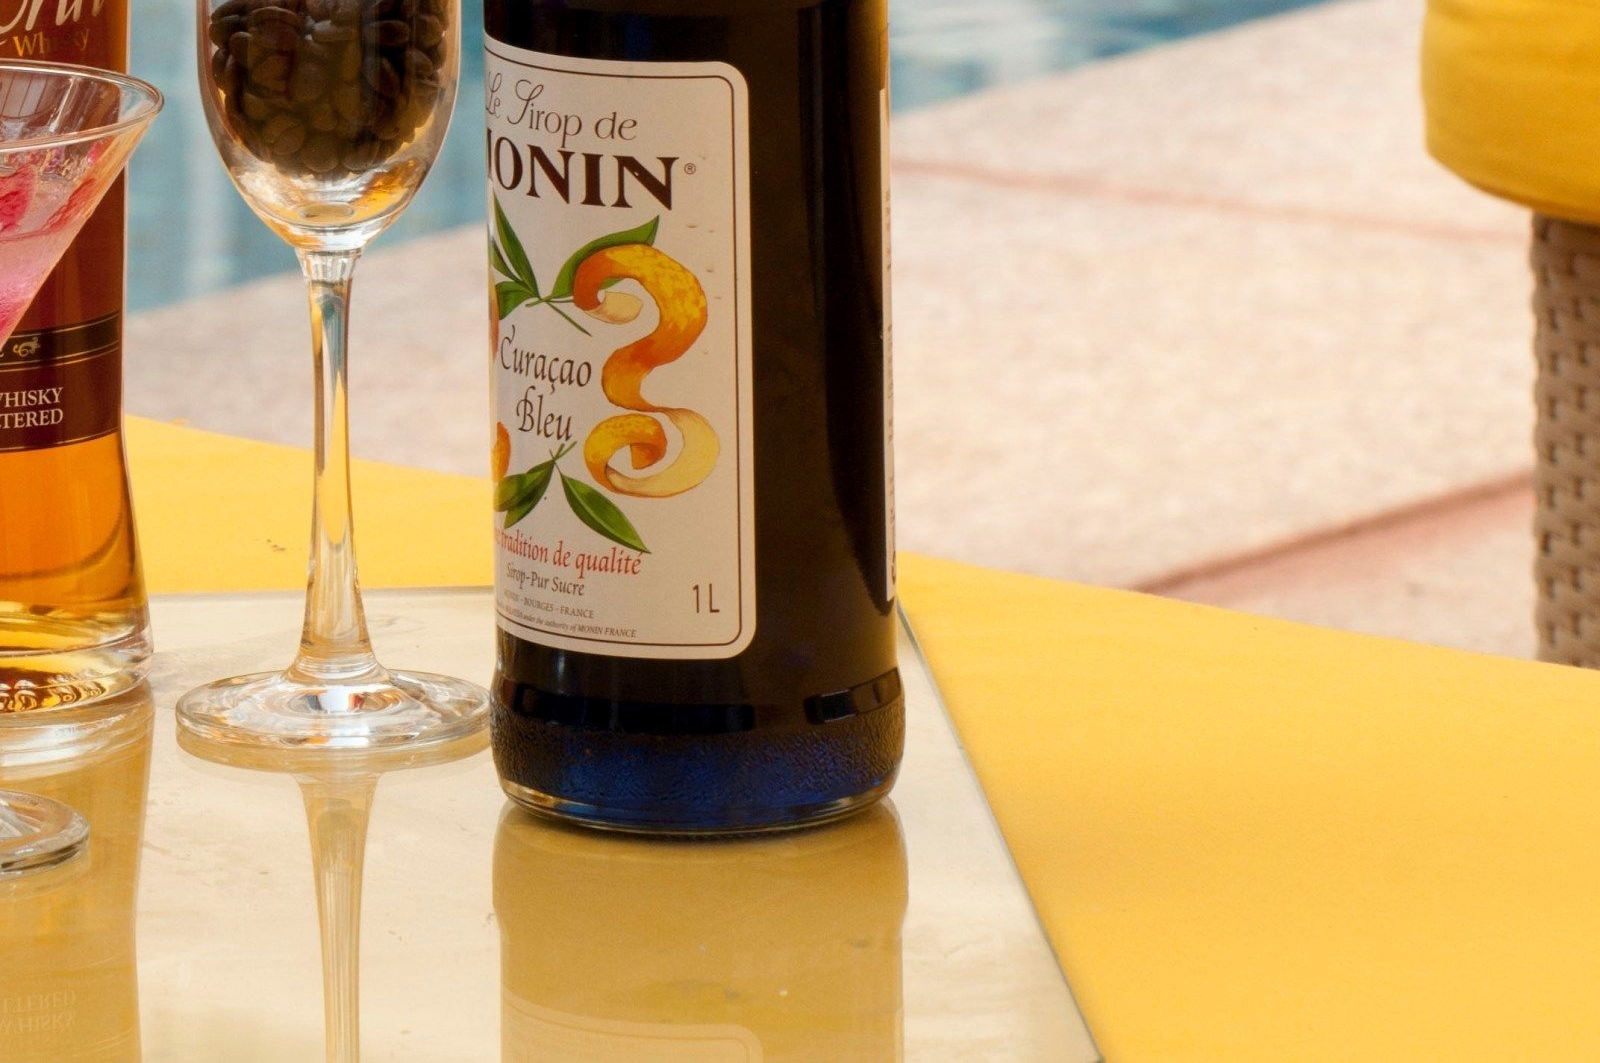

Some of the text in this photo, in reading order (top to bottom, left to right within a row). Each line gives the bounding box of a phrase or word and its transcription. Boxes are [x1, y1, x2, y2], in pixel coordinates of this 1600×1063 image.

[507, 79, 583, 149] Sirop
[595, 112, 637, 140] de
[501, 324, 592, 394] Curaçao
[516, 385, 572, 441] Bleu
[553, 540, 571, 568] de
[576, 546, 644, 579] qualité
[551, 576, 585, 596] Sucre
[523, 598, 554, 612] BOURGES
[560, 605, 595, 619] FRANCE
[578, 623, 603, 635] MONIN
[604, 627, 637, 638] FRANCE
